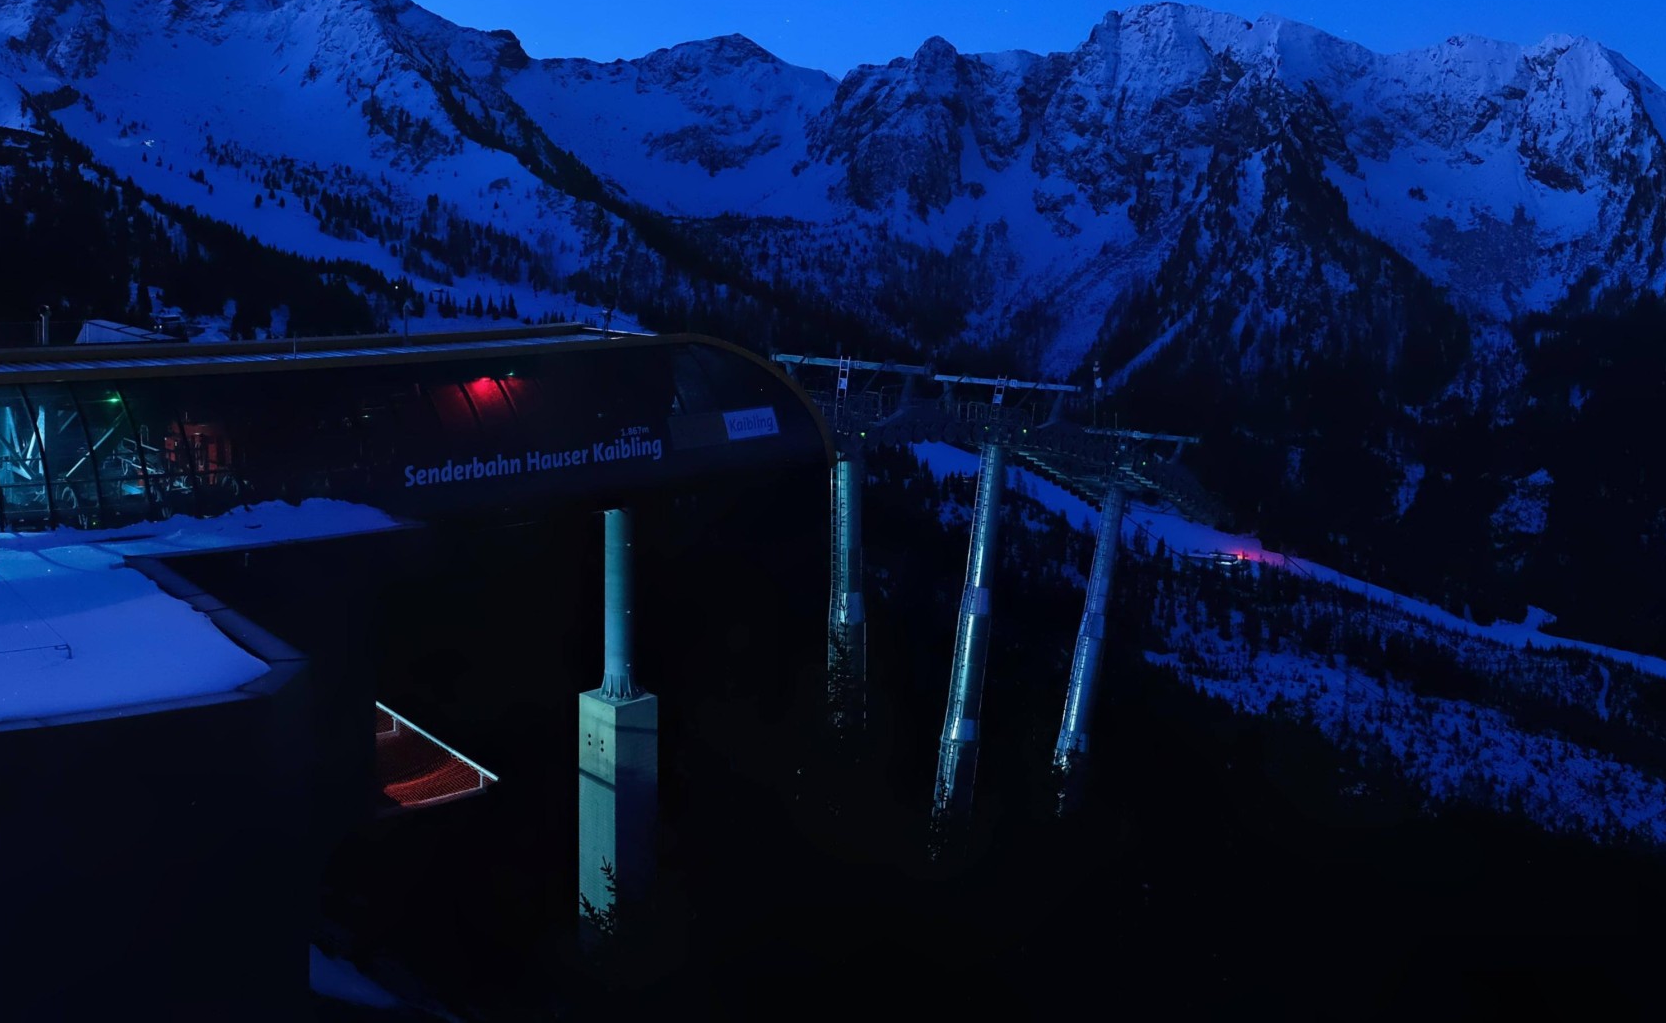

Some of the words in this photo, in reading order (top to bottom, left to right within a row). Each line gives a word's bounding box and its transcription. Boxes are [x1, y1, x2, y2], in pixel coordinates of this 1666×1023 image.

[728, 414, 774, 432] Kaibling
[404, 454, 521, 487] Senderbahn
[526, 449, 589, 471] Hauser
[593, 436, 662, 463] Kaibling
